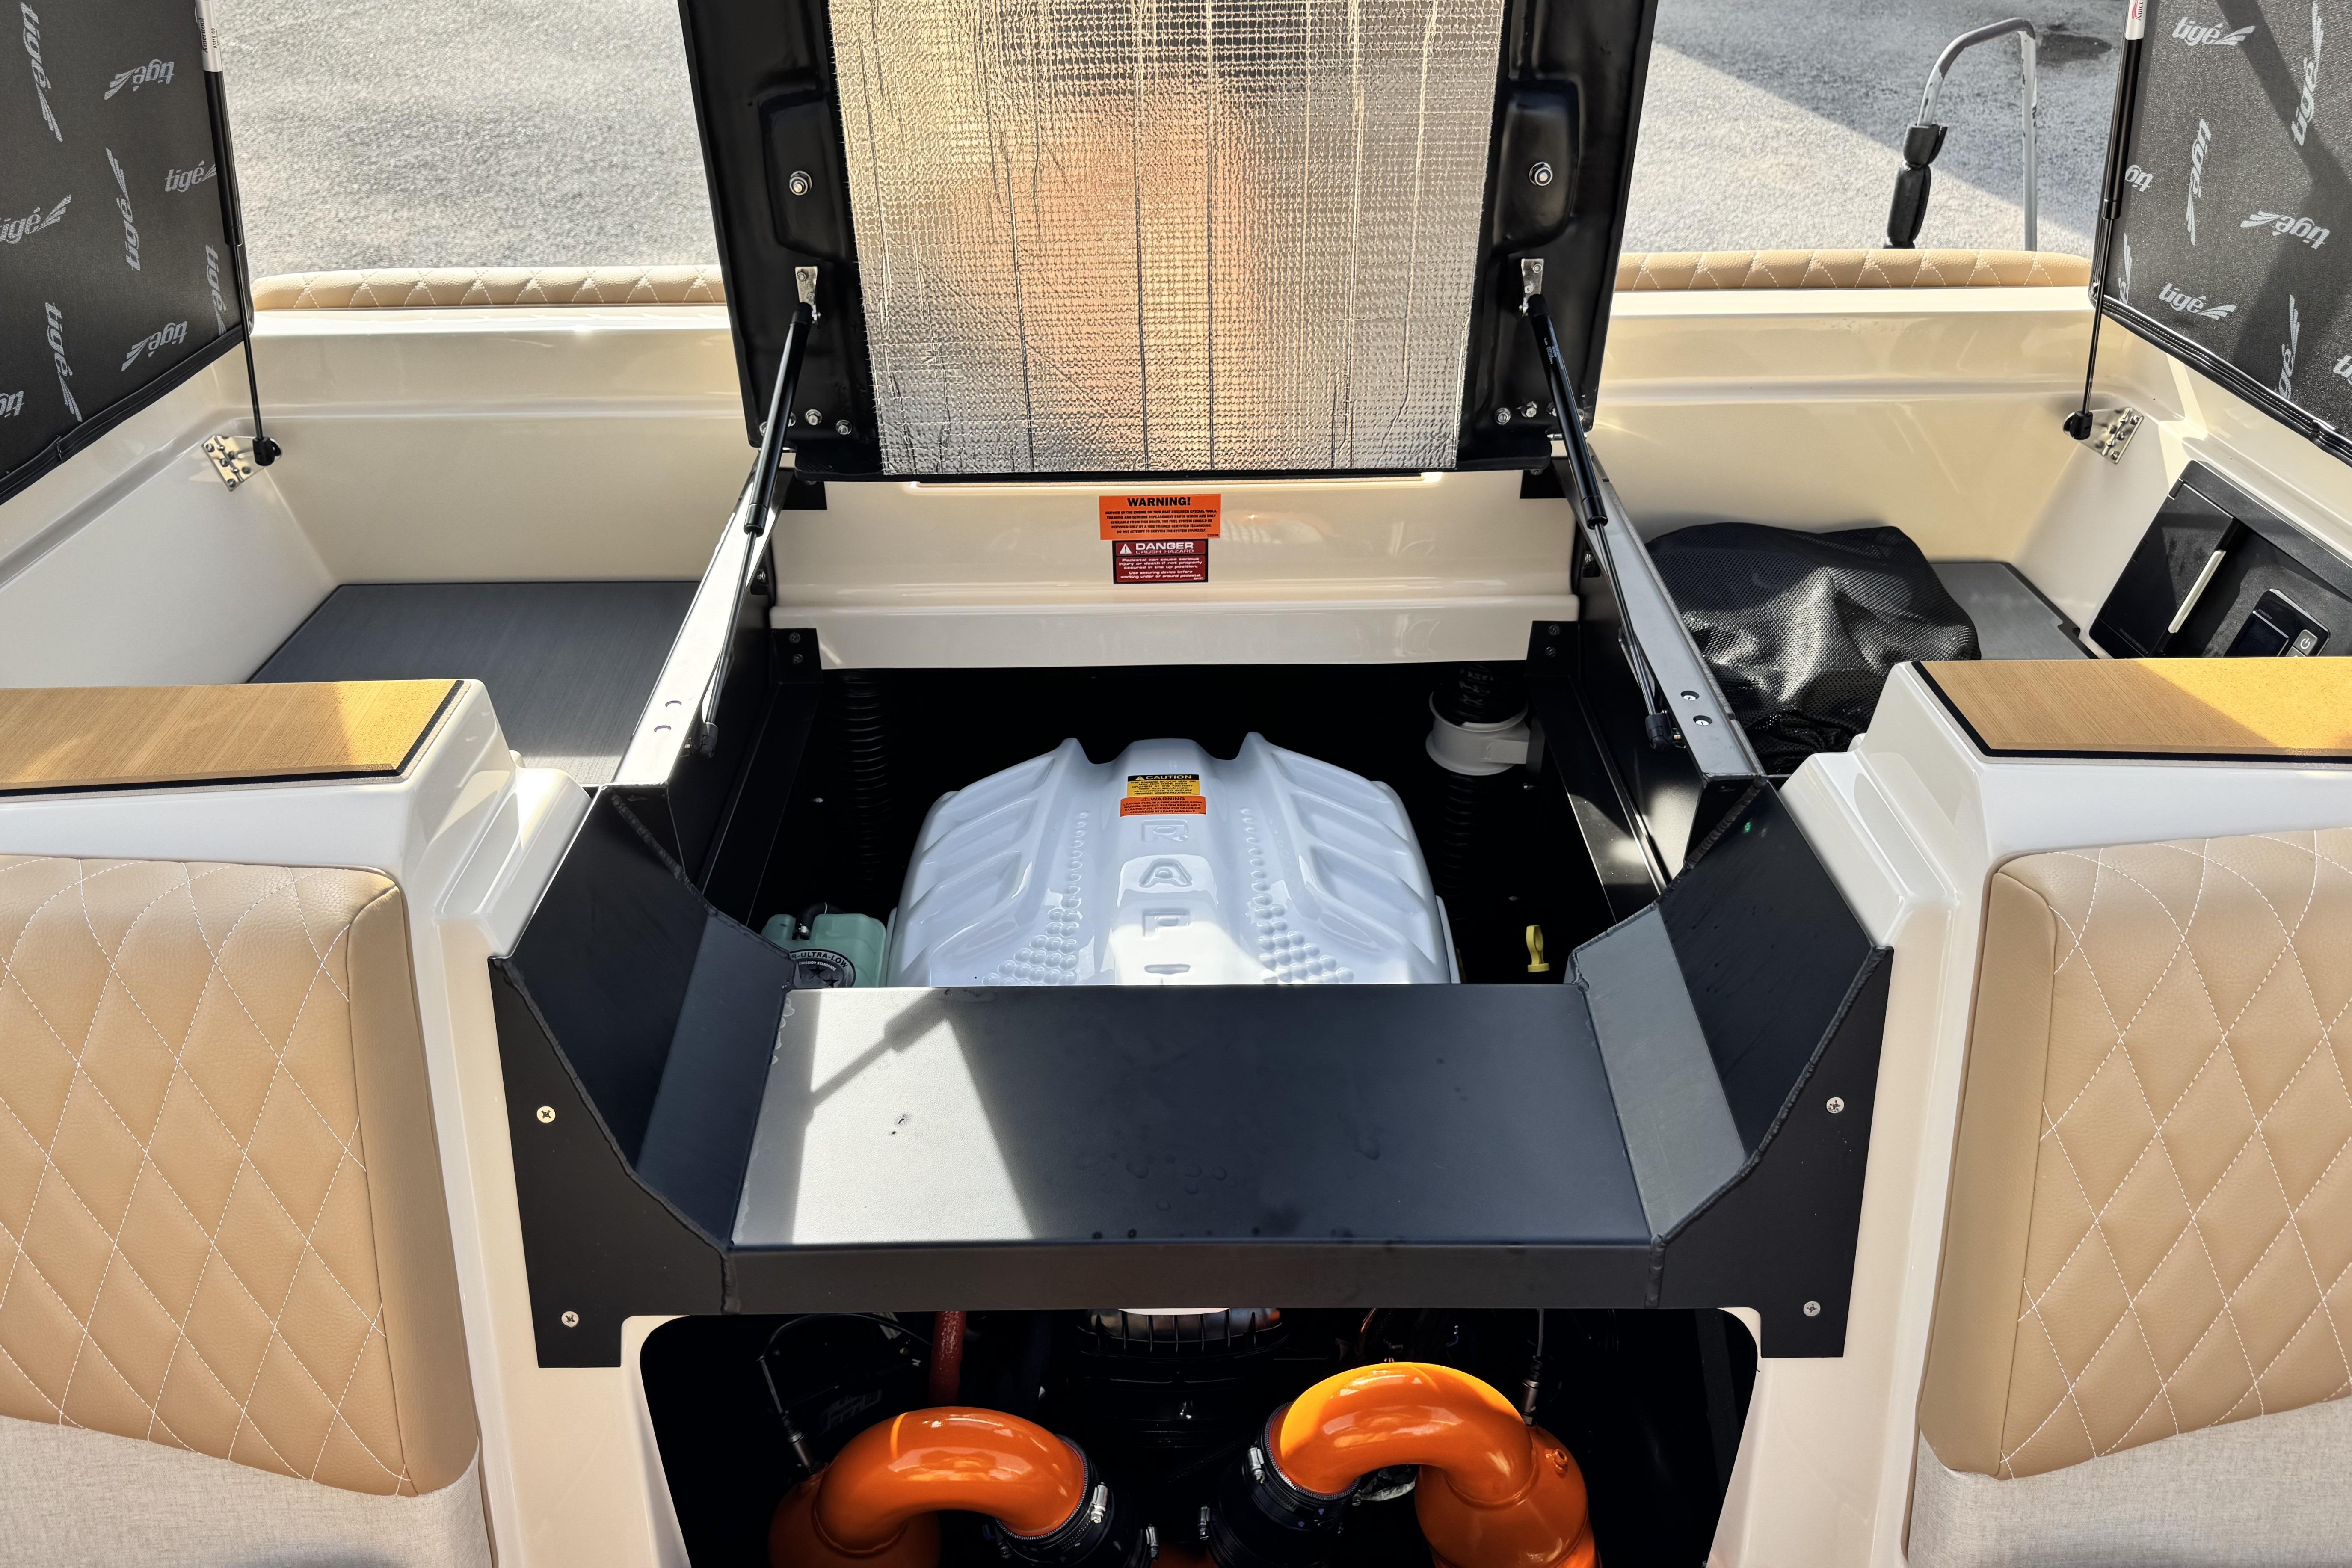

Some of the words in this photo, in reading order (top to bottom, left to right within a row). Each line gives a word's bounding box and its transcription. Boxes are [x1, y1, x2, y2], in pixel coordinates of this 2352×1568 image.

[21, 2, 51, 89] tigé
[198, 18, 208, 53] Ameritool
[2171, 16, 2224, 46] tigé
[131, 59, 174, 92] tigé
[2291, 58, 2317, 146] tigé
[2190, 118, 2211, 198] tigé
[165, 160, 204, 193] tigé
[2125, 164, 2153, 192] tig
[0, 206, 41, 244] igé
[116, 197, 141, 271] tigé
[2272, 215, 2330, 249] tigé
[206, 245, 226, 311] tigé
[2158, 282, 2207, 314] tigé
[45, 302, 73, 377] tigé
[148, 320, 187, 358] tigé
[0, 390, 24, 418] tig
[1127, 497, 1191, 507] WARNING!
[1136, 542, 1194, 550] DANGER
[792, 952, 848, 968] R-ULTRA-LOW
